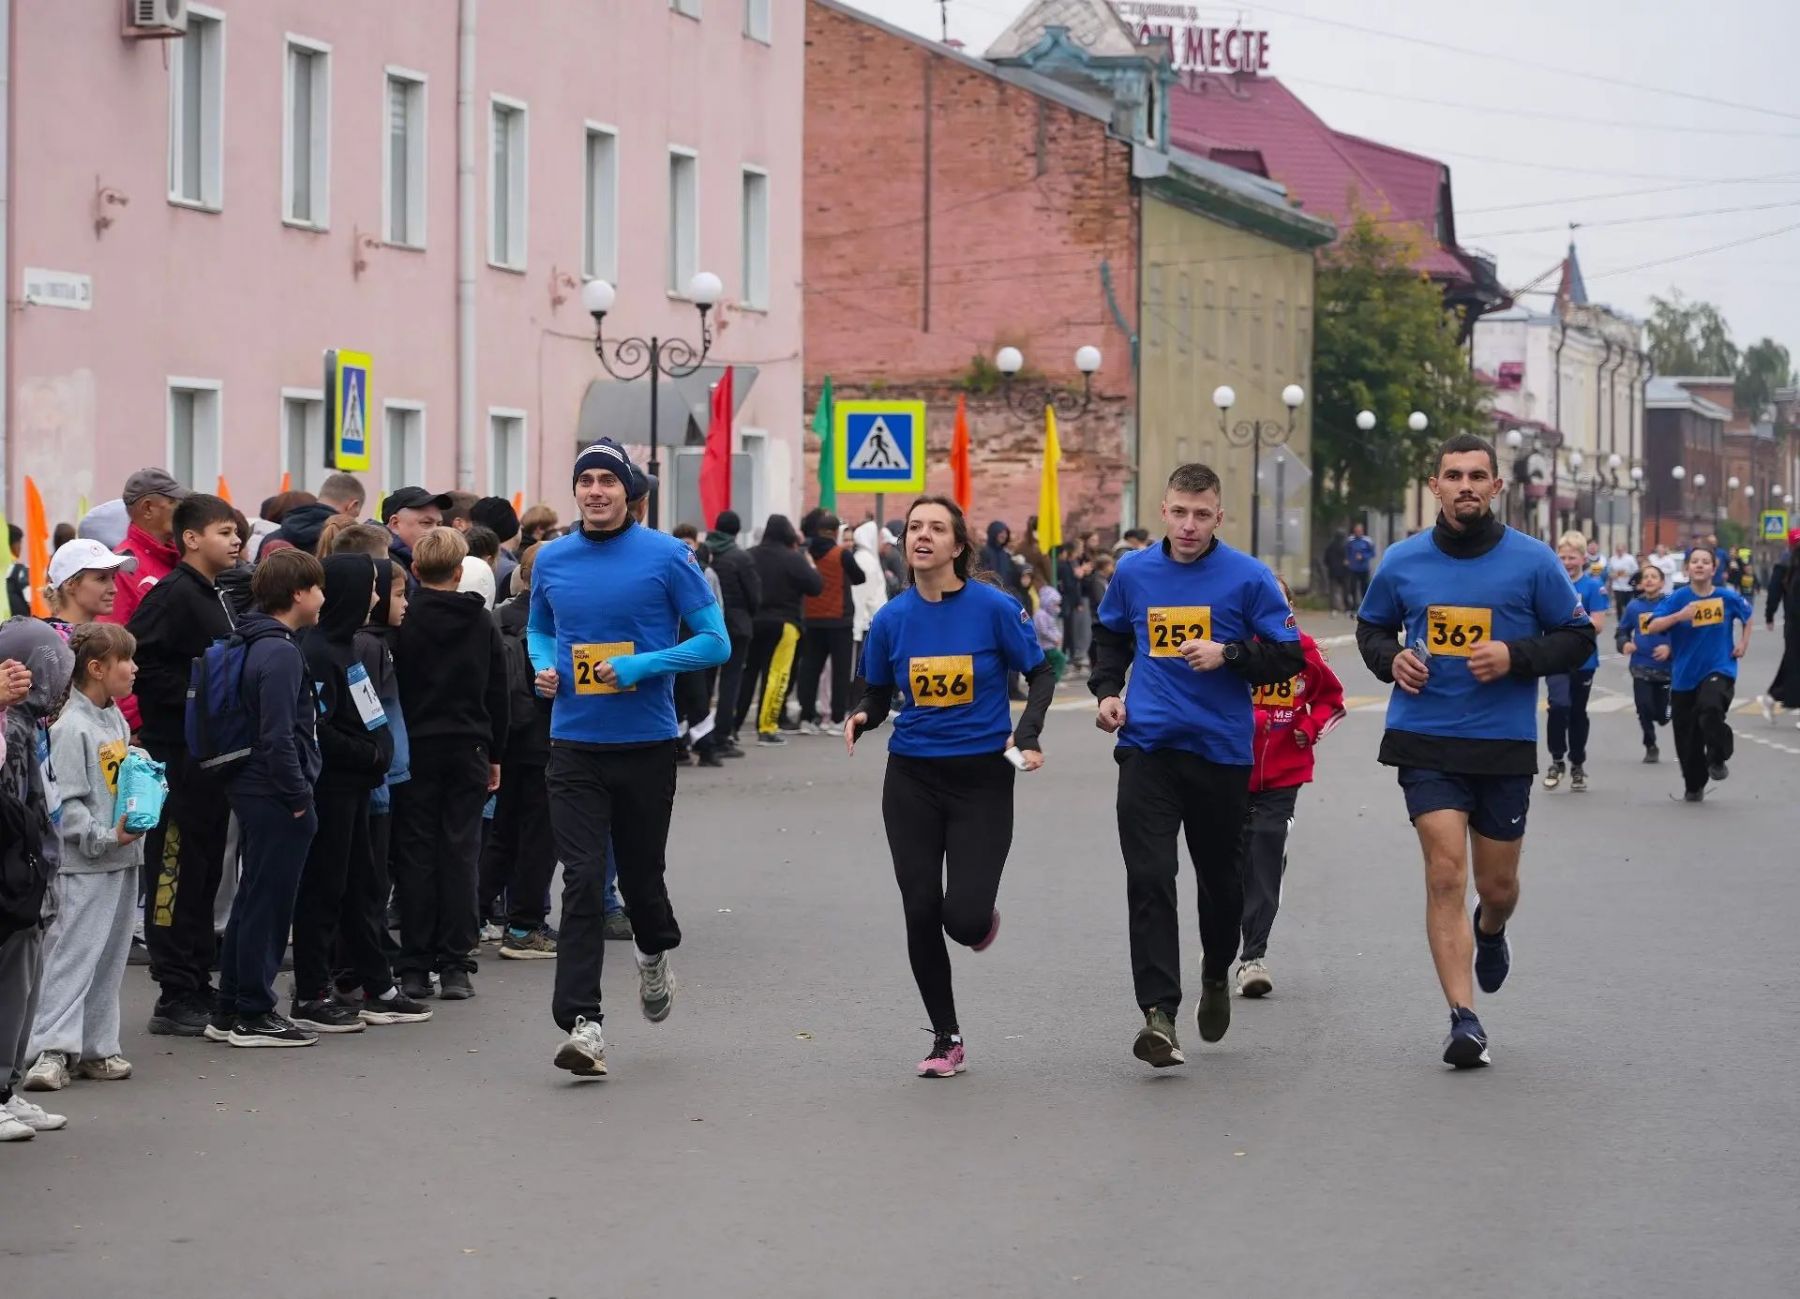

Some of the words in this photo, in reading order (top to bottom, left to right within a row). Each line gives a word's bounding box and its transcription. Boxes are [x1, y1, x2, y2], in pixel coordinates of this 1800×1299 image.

[1185, 26, 1269, 69] МЕСТЕ
[1694, 605, 1722, 621] 484
[1154, 623, 1204, 647] 252
[1433, 622, 1483, 647] 362
[915, 674, 968, 697] 236
